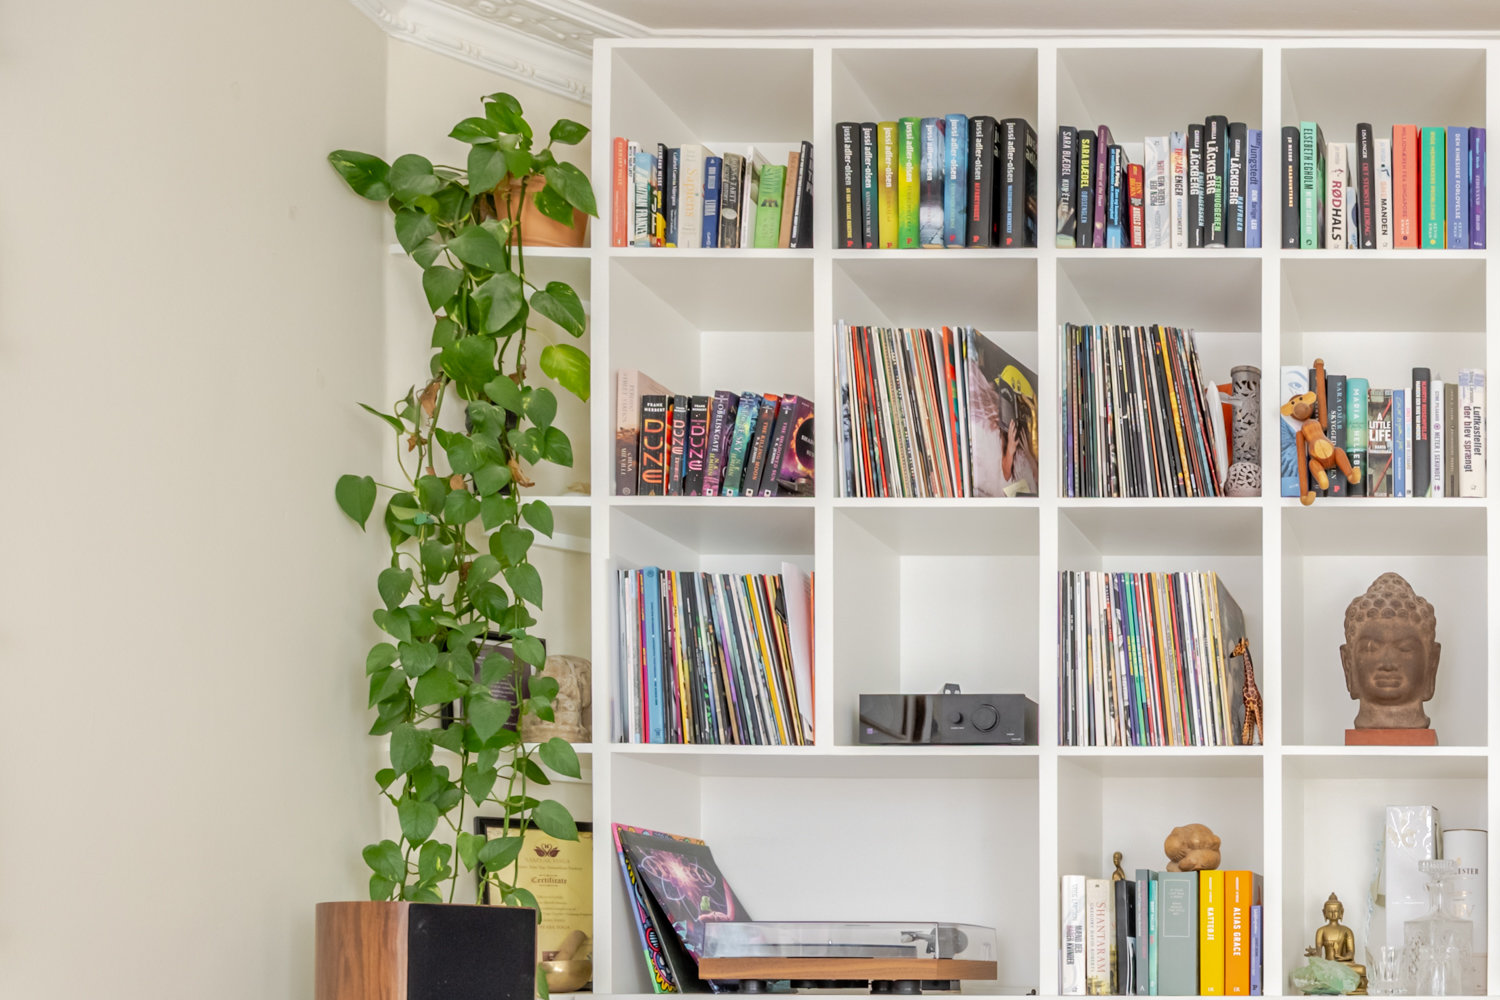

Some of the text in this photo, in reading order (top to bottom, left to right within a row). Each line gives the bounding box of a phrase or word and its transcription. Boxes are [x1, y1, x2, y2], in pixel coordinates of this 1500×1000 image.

[883, 128, 893, 144] jussi
[904, 122, 914, 139] jussi
[926, 125, 934, 141] jussi
[950, 119, 959, 136] jussi
[1304, 128, 1313, 160] ELSEBETH
[842, 126, 853, 185] jussi adler-olsen
[863, 127, 873, 188] jussi adler-olsen
[885, 146, 894, 187] adler-olsen
[906, 141, 914, 182] adler-olsen
[950, 138, 959, 180] adler-olsen
[975, 120, 984, 180] jussi adler-olsen
[1007, 122, 1016, 182] jussi adler-olsen
[1062, 131, 1071, 175] SARA BLÆDEL
[1081, 139, 1090, 188] SARA BLÆDEL
[1206, 140, 1218, 195] LÄCKBERG
[1248, 145, 1259, 185] Jungstedt
[683, 168, 699, 217] Sapiens
[729, 182, 737, 203] TARTT
[1175, 148, 1183, 196] THOMAS ENGER
[1190, 149, 1201, 195] LÄCKBERG
[1229, 157, 1241, 205] LÄCKBERG
[1304, 162, 1313, 190] EGHOLM
[1331, 180, 1342, 241] RØDHALS
[711, 404, 724, 452] OBELISK GATE
[1369, 421, 1391, 429] LITTLE
[1370, 430, 1391, 442] LIFE
[1376, 412, 1383, 420] A
[1473, 406, 1482, 456] Luftkastellet
[642, 419, 664, 484] DUNE
[734, 436, 744, 453] SKY
[757, 432, 766, 460] KILLING
[1463, 406, 1472, 472] der blev sprængt
[752, 462, 761, 480] MOON
[1075, 943, 1083, 954] DER
[1095, 902, 1106, 973] SHANTARAM
[1233, 907, 1241, 956] ALIAS GRACE
[1066, 943, 1075, 965] KVINDER
